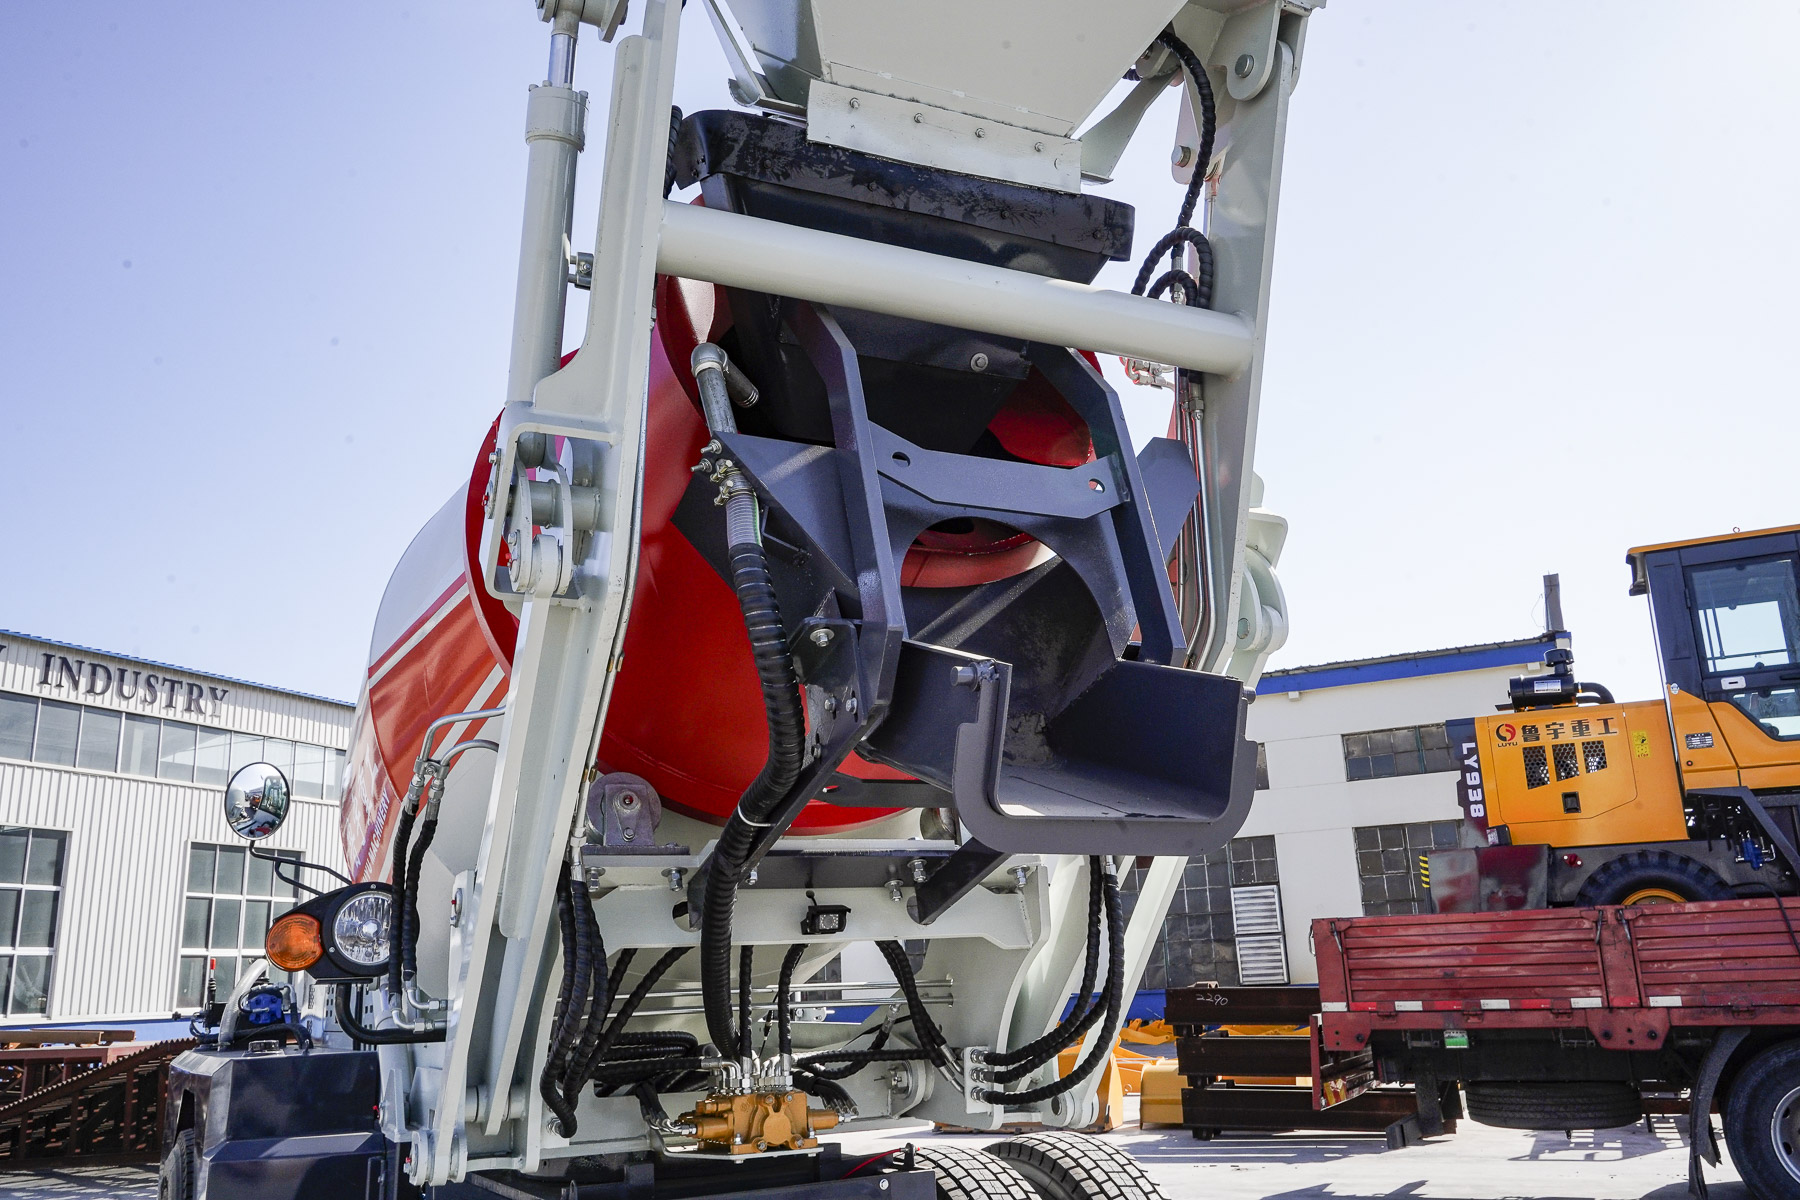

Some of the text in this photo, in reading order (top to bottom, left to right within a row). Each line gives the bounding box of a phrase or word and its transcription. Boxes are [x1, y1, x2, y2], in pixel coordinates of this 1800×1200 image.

[40, 653, 229, 717] INDUSTRY
[1521, 717, 1618, 743] 鲁宇重工
[1462, 742, 1485, 818] LY938
[368, 787, 390, 865] MACHINERY
[1195, 993, 1229, 1005] 2290
